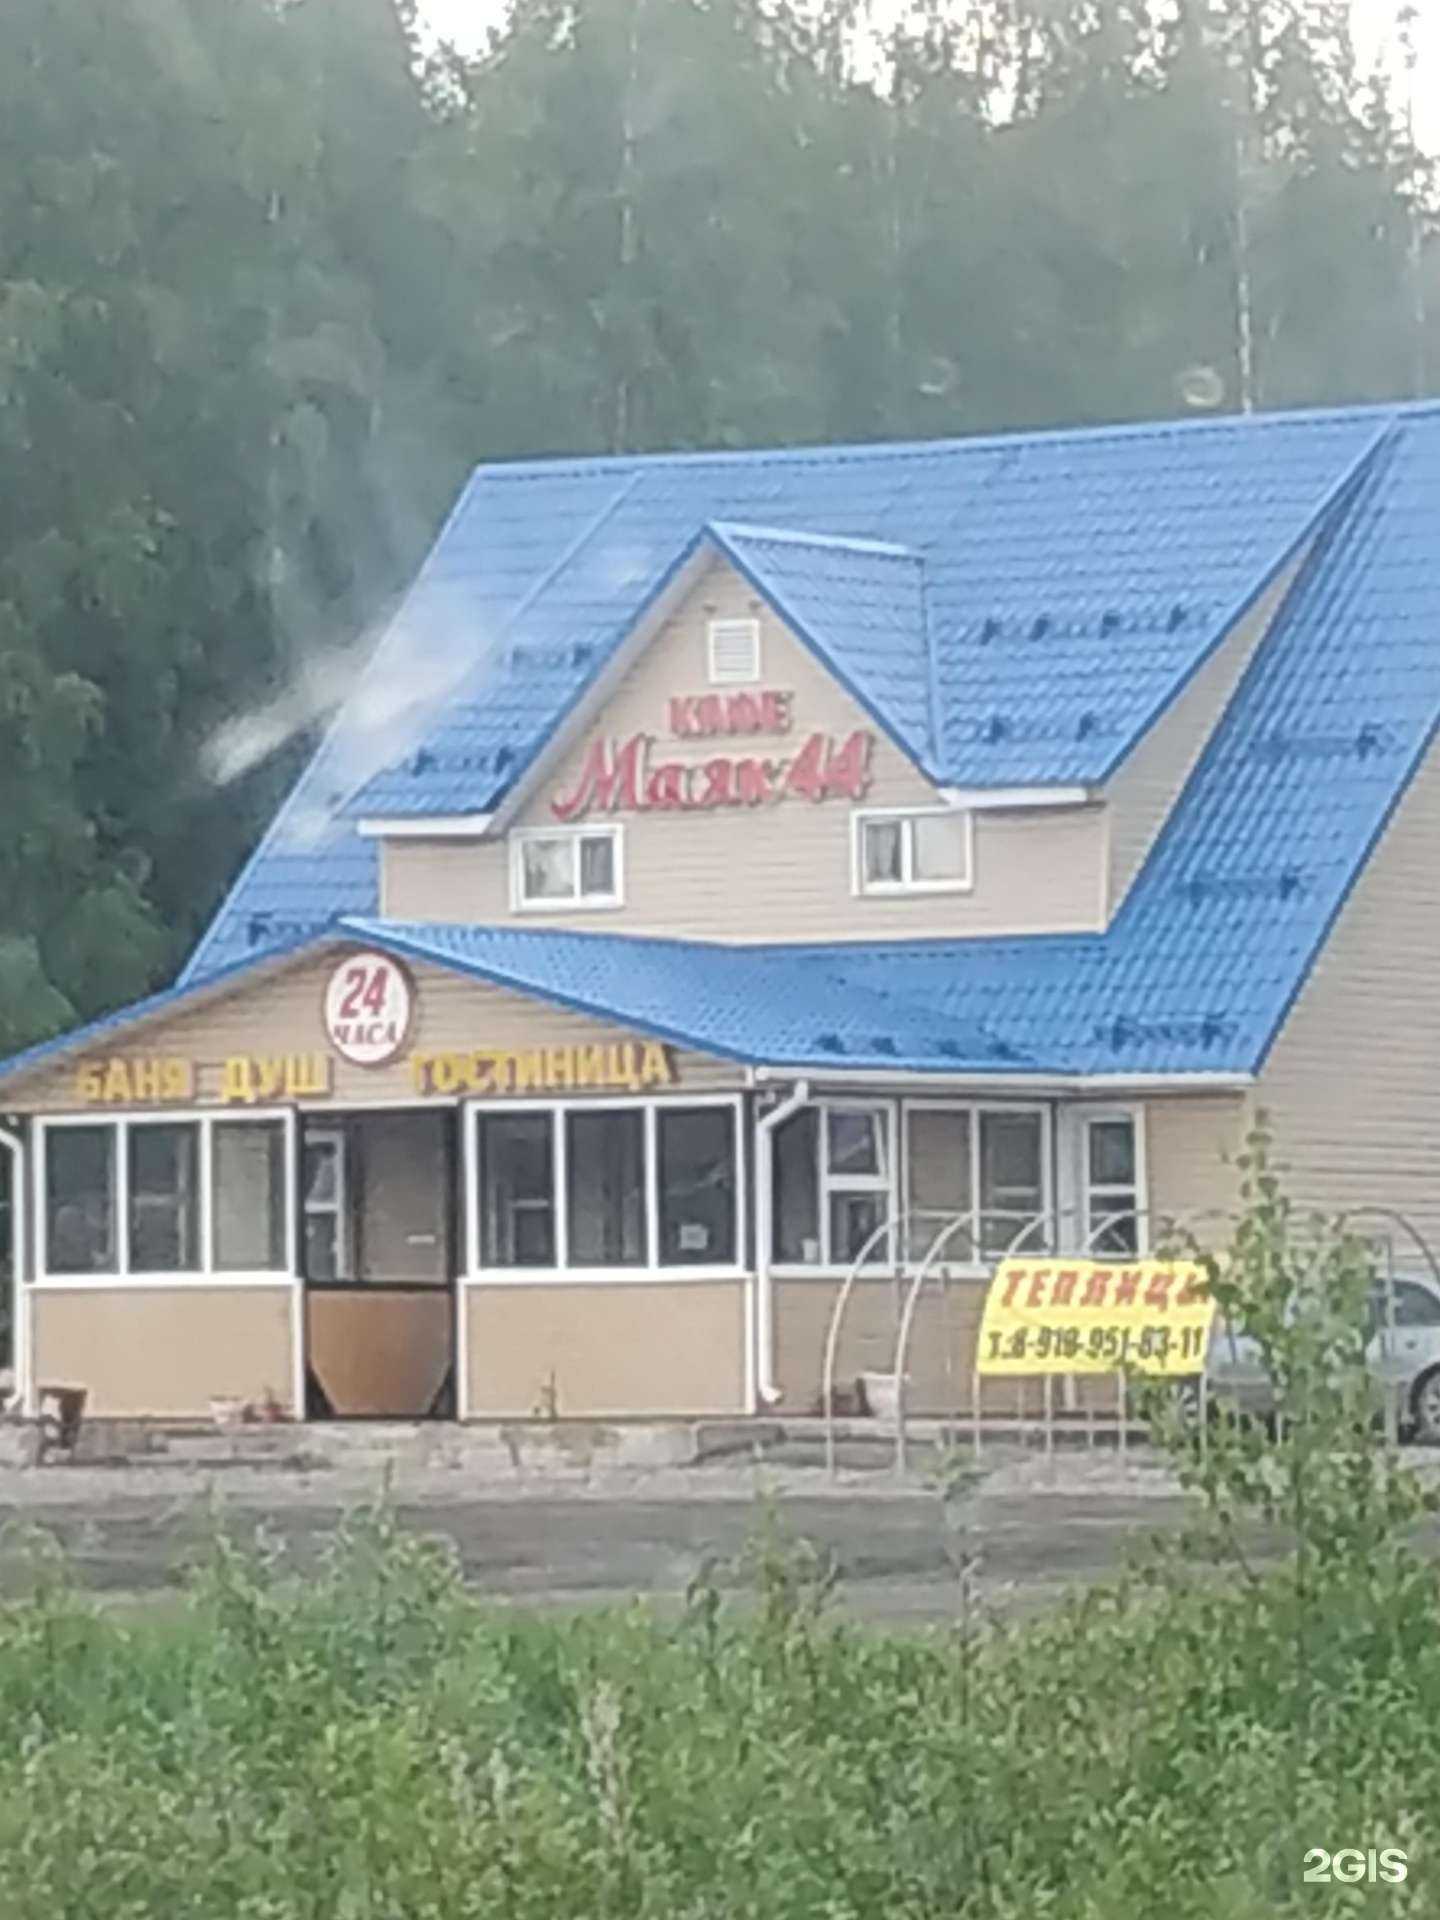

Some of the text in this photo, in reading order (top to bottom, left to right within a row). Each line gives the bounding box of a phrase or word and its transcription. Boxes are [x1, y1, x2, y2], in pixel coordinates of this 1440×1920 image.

[340, 966, 388, 1018] 24
[334, 1021, 397, 1044] ЧАСА
[75, 1041, 675, 1103] БАНЯ ДУШ ГОСТИНИЦА
